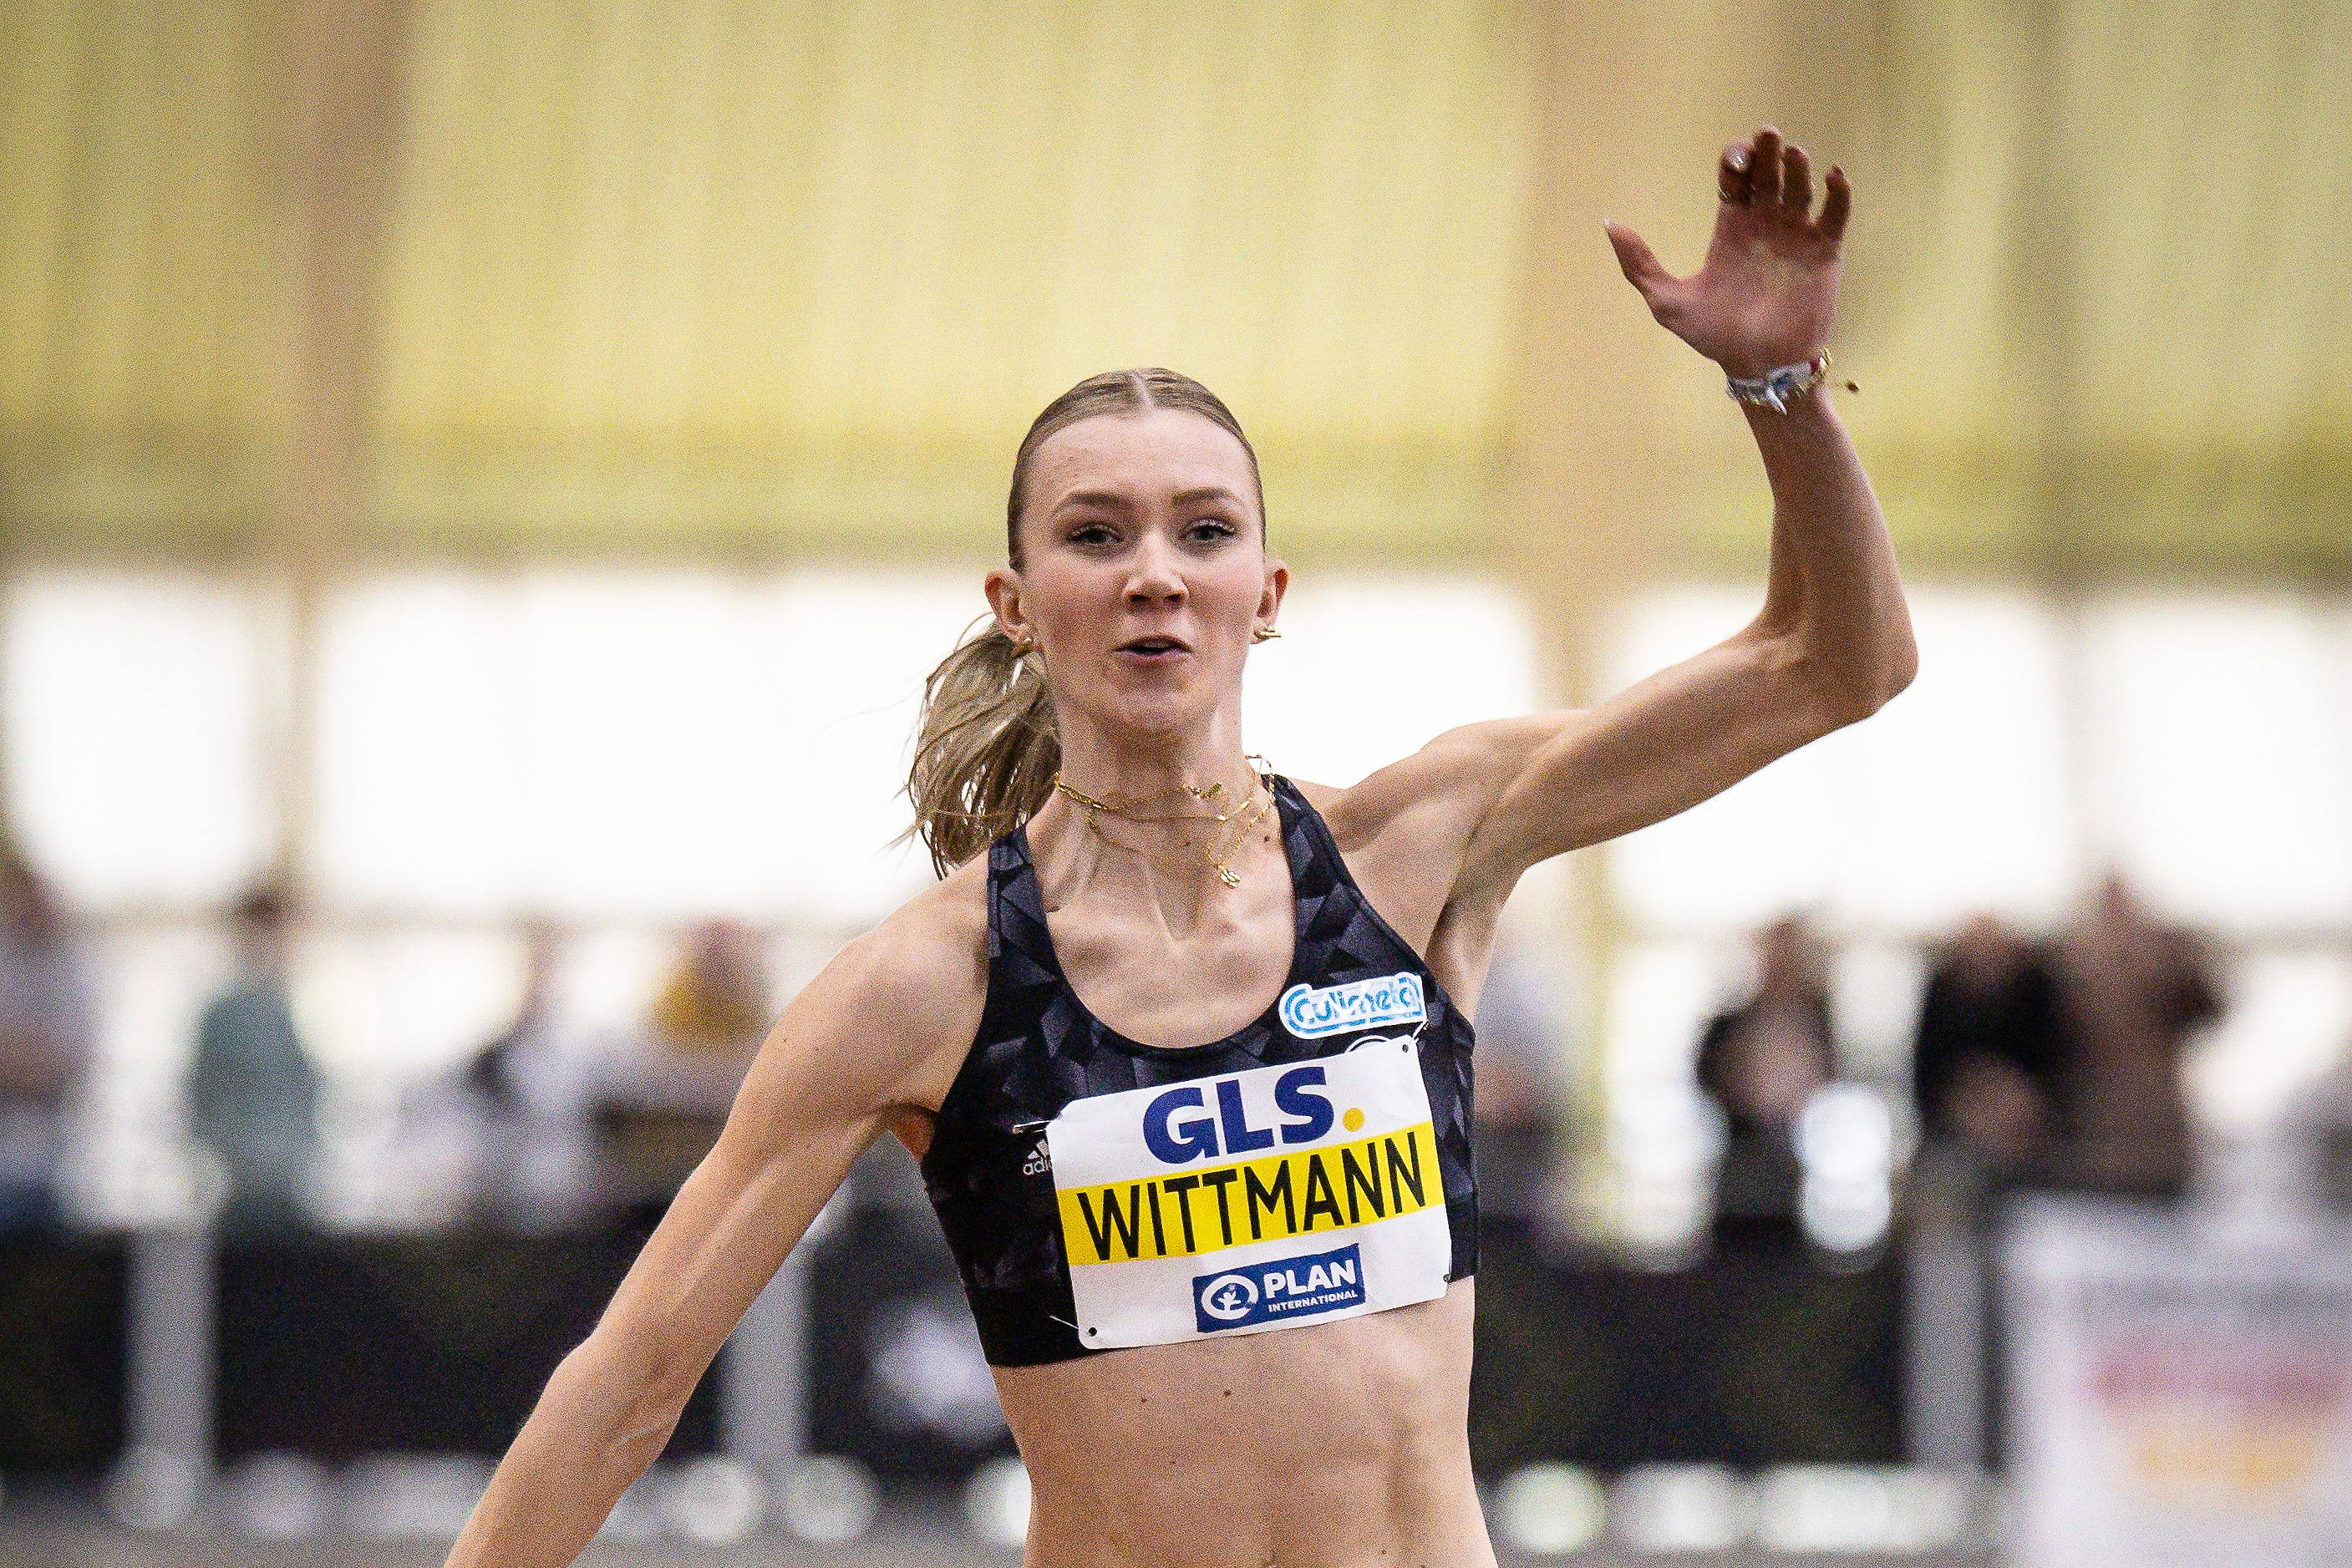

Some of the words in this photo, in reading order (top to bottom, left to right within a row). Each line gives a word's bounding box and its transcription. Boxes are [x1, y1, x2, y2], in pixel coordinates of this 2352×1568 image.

[1076, 1132, 1425, 1261] WITTMANN
[1262, 1259, 1357, 1299] PLAN
[1268, 1290, 1359, 1312] INTERNATIONAL
